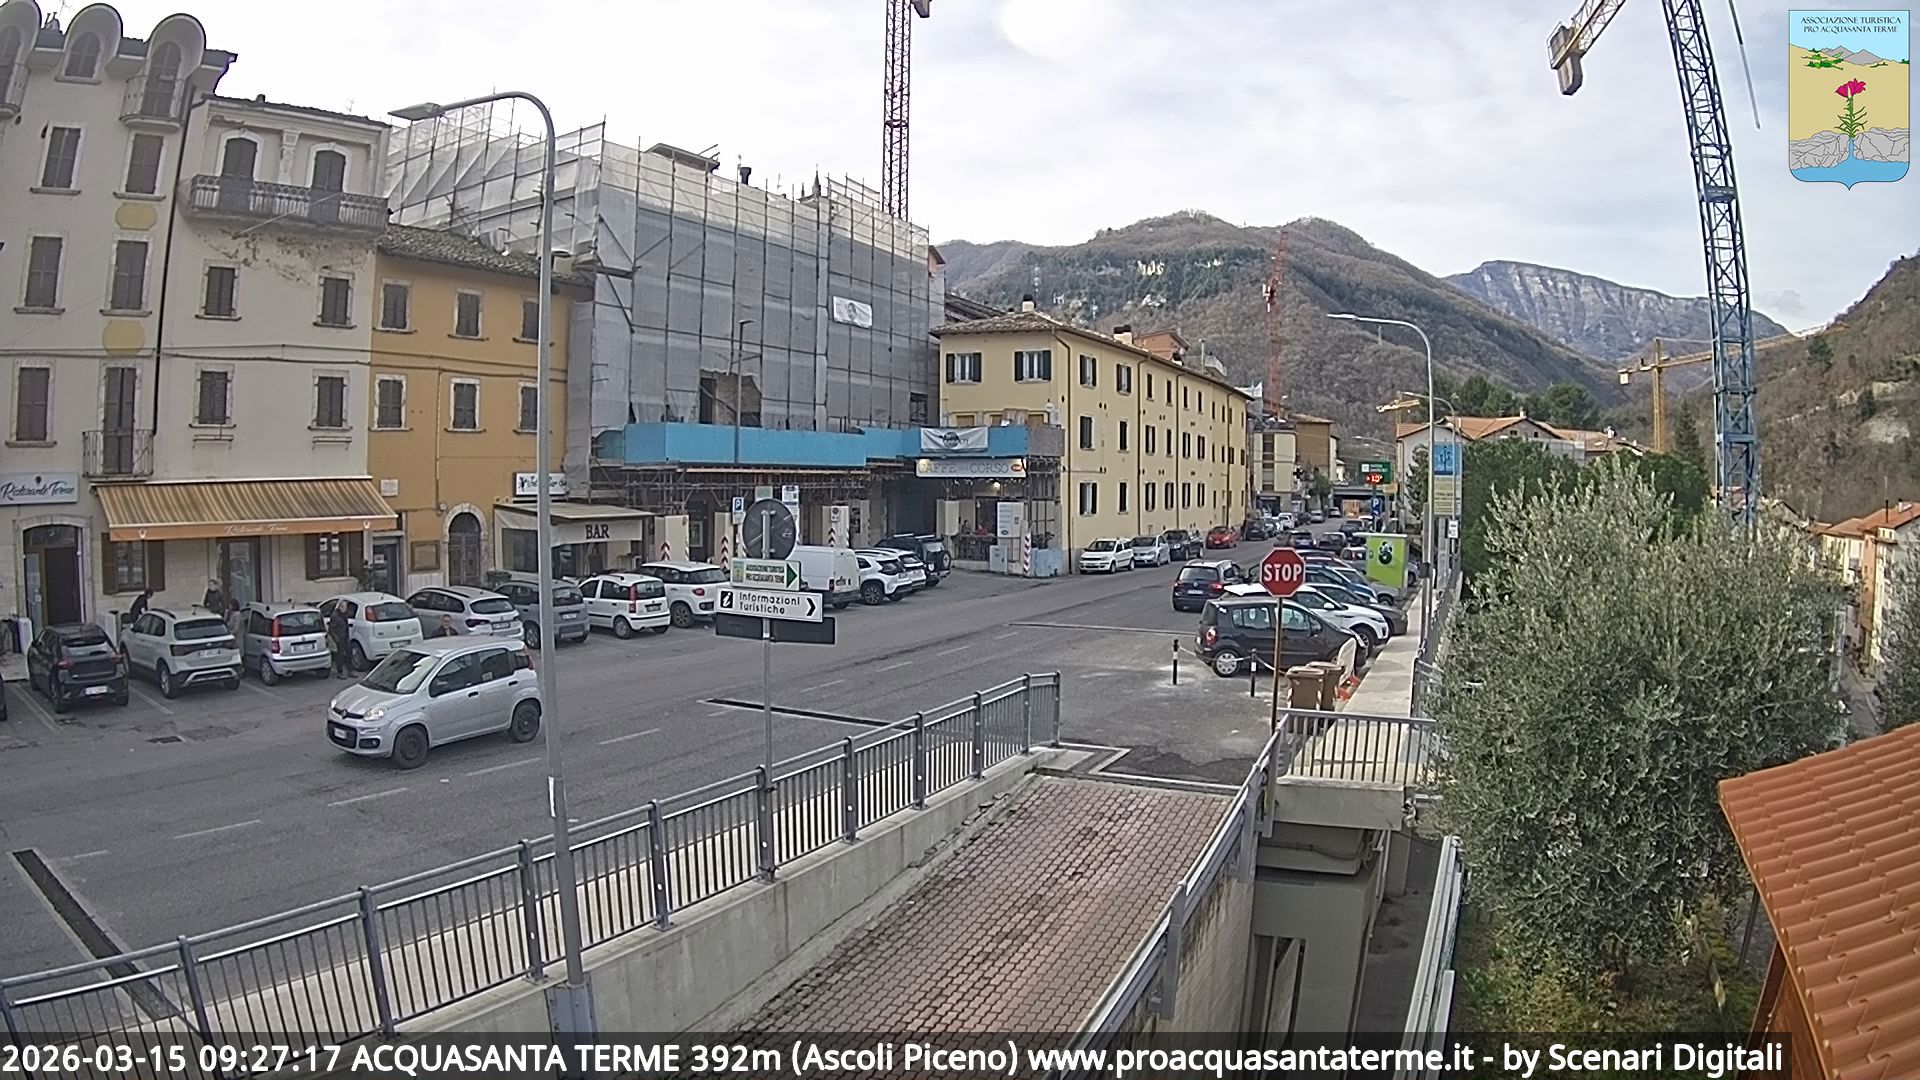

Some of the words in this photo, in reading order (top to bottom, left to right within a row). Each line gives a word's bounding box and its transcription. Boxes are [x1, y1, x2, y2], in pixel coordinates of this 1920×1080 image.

[969, 463, 1009, 473] CORSO
[585, 524, 610, 539] BAR
[1263, 563, 1303, 582] STOP
[739, 591, 801, 606] Informazioni
[739, 601, 786, 615] Turistiche
